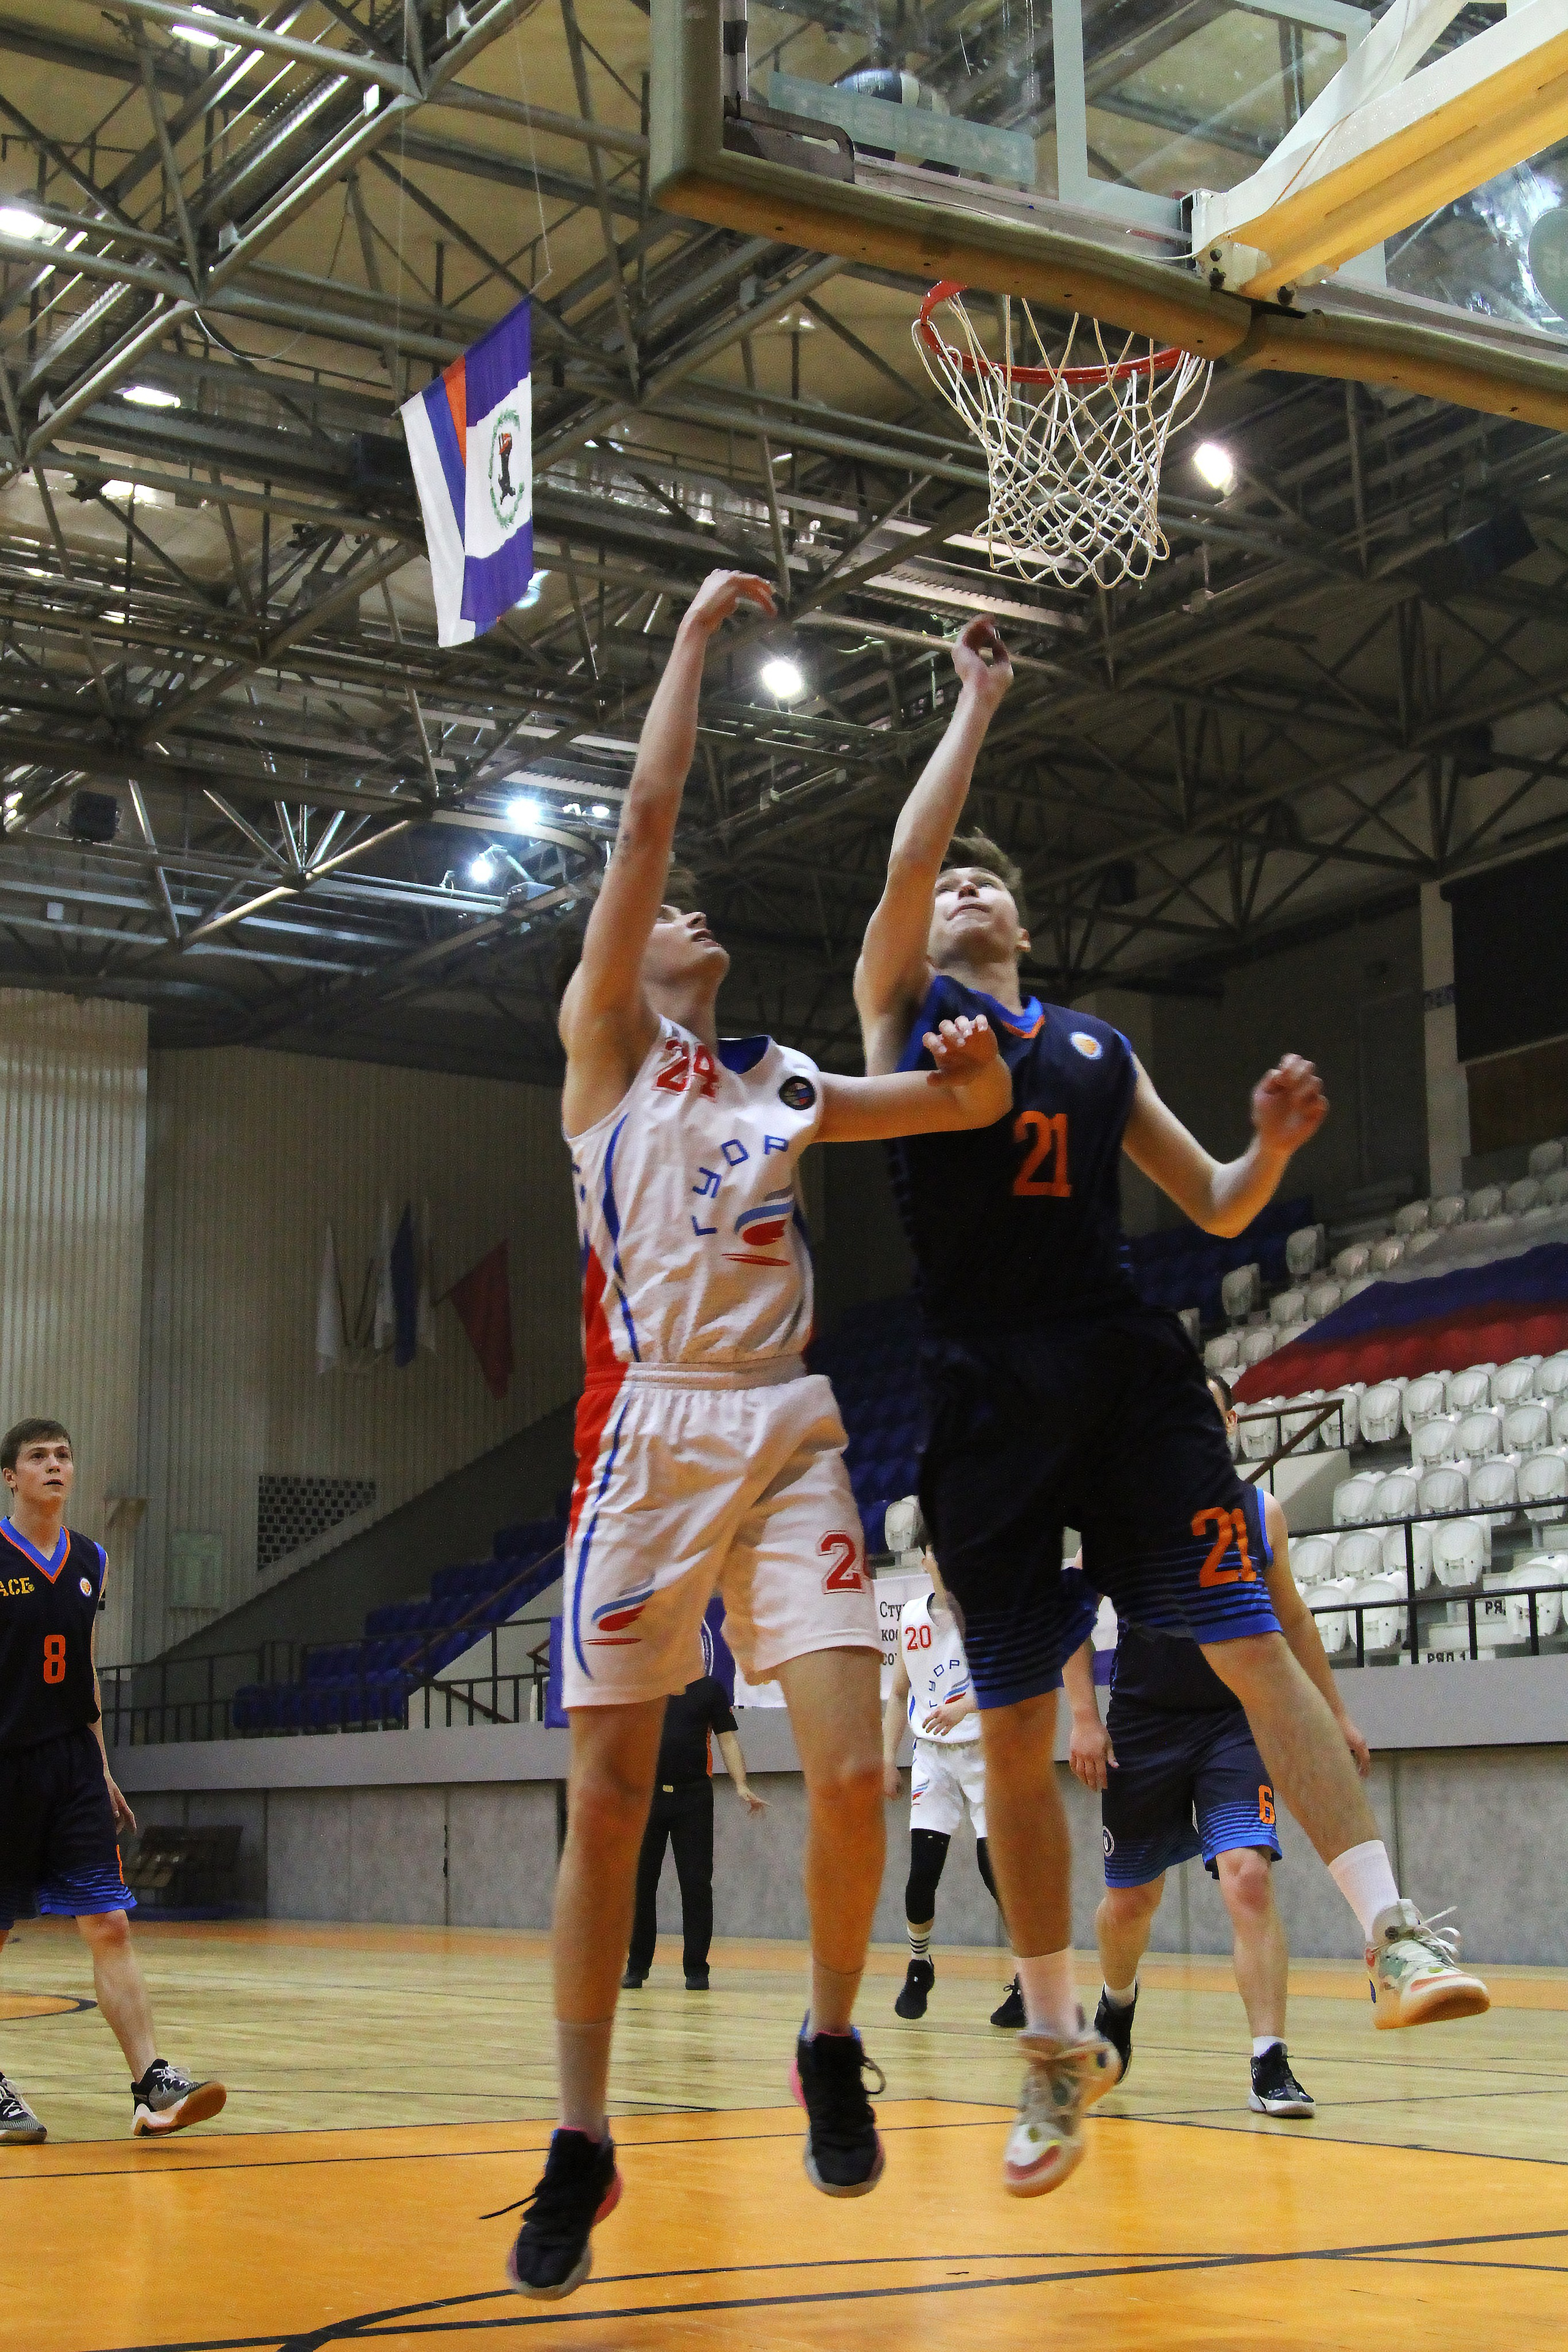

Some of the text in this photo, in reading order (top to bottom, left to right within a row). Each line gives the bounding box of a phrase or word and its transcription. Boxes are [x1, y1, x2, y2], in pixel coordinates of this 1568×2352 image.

[652, 1036, 720, 1099] 24
[1014, 1110, 1071, 1198] 21
[1191, 1506, 1257, 1588] 21
[880, 1600, 905, 1621] Сту
[1485, 1600, 1506, 1616] РЯ
[905, 1624, 932, 1652] 20
[43, 1634, 66, 1684] 8
[882, 1653, 897, 1665] со
[1258, 1784, 1275, 1825] 6
